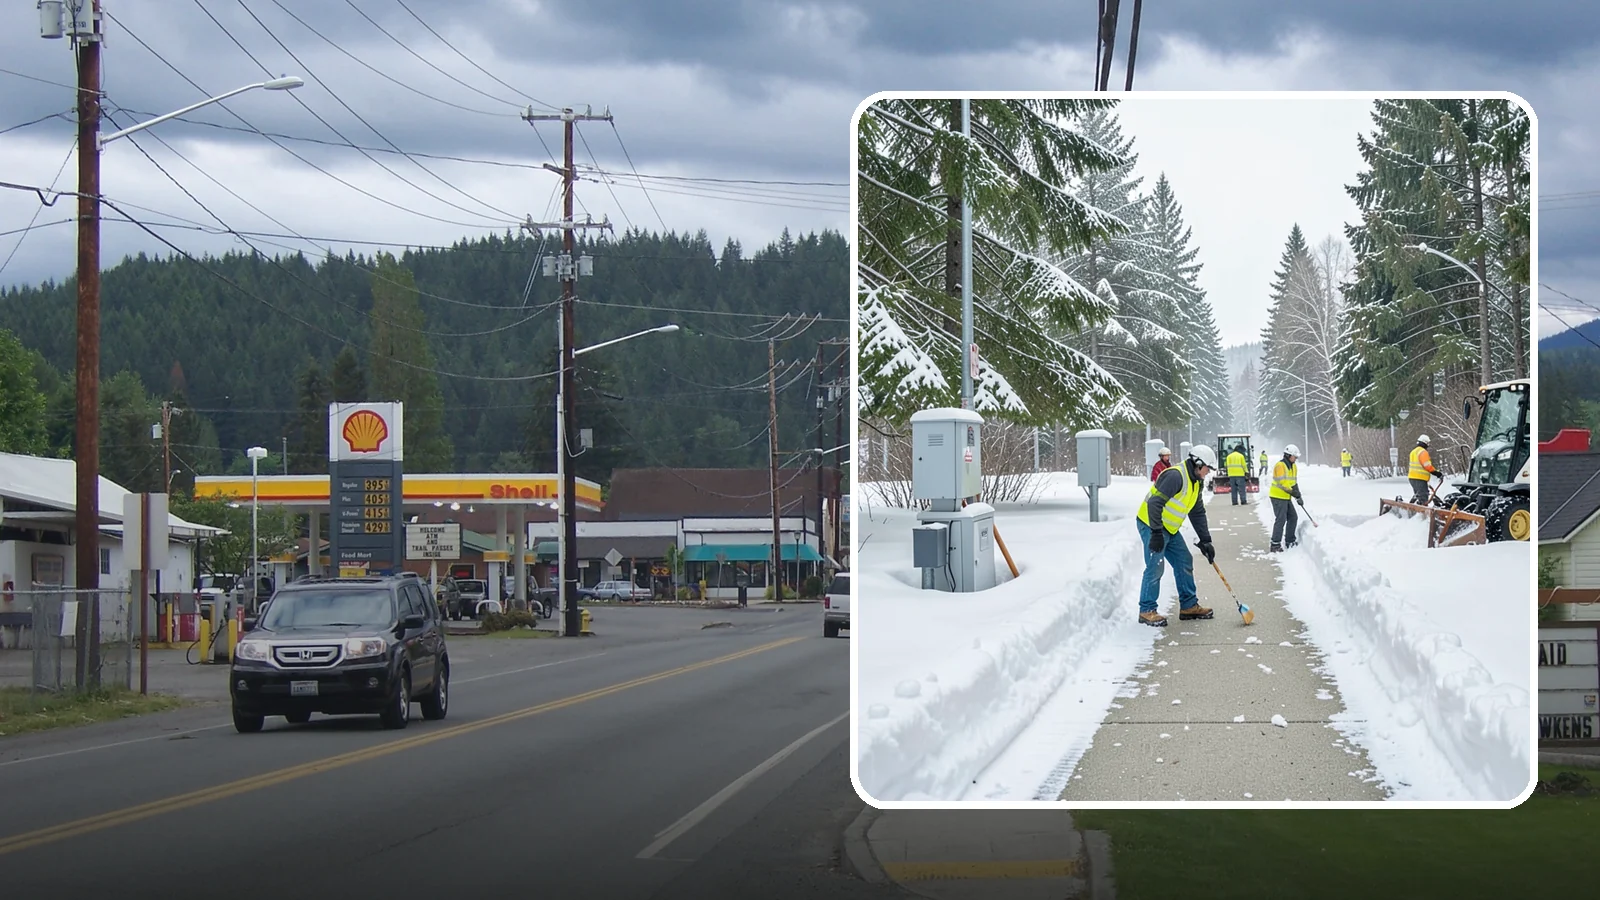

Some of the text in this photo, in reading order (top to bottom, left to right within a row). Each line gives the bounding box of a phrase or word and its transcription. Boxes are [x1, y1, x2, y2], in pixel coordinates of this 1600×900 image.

[366, 480, 383, 490] 395
[490, 484, 547, 499] Shell
[366, 494, 383, 504] 405
[366, 508, 383, 518] 415
[366, 522, 383, 532] 429
